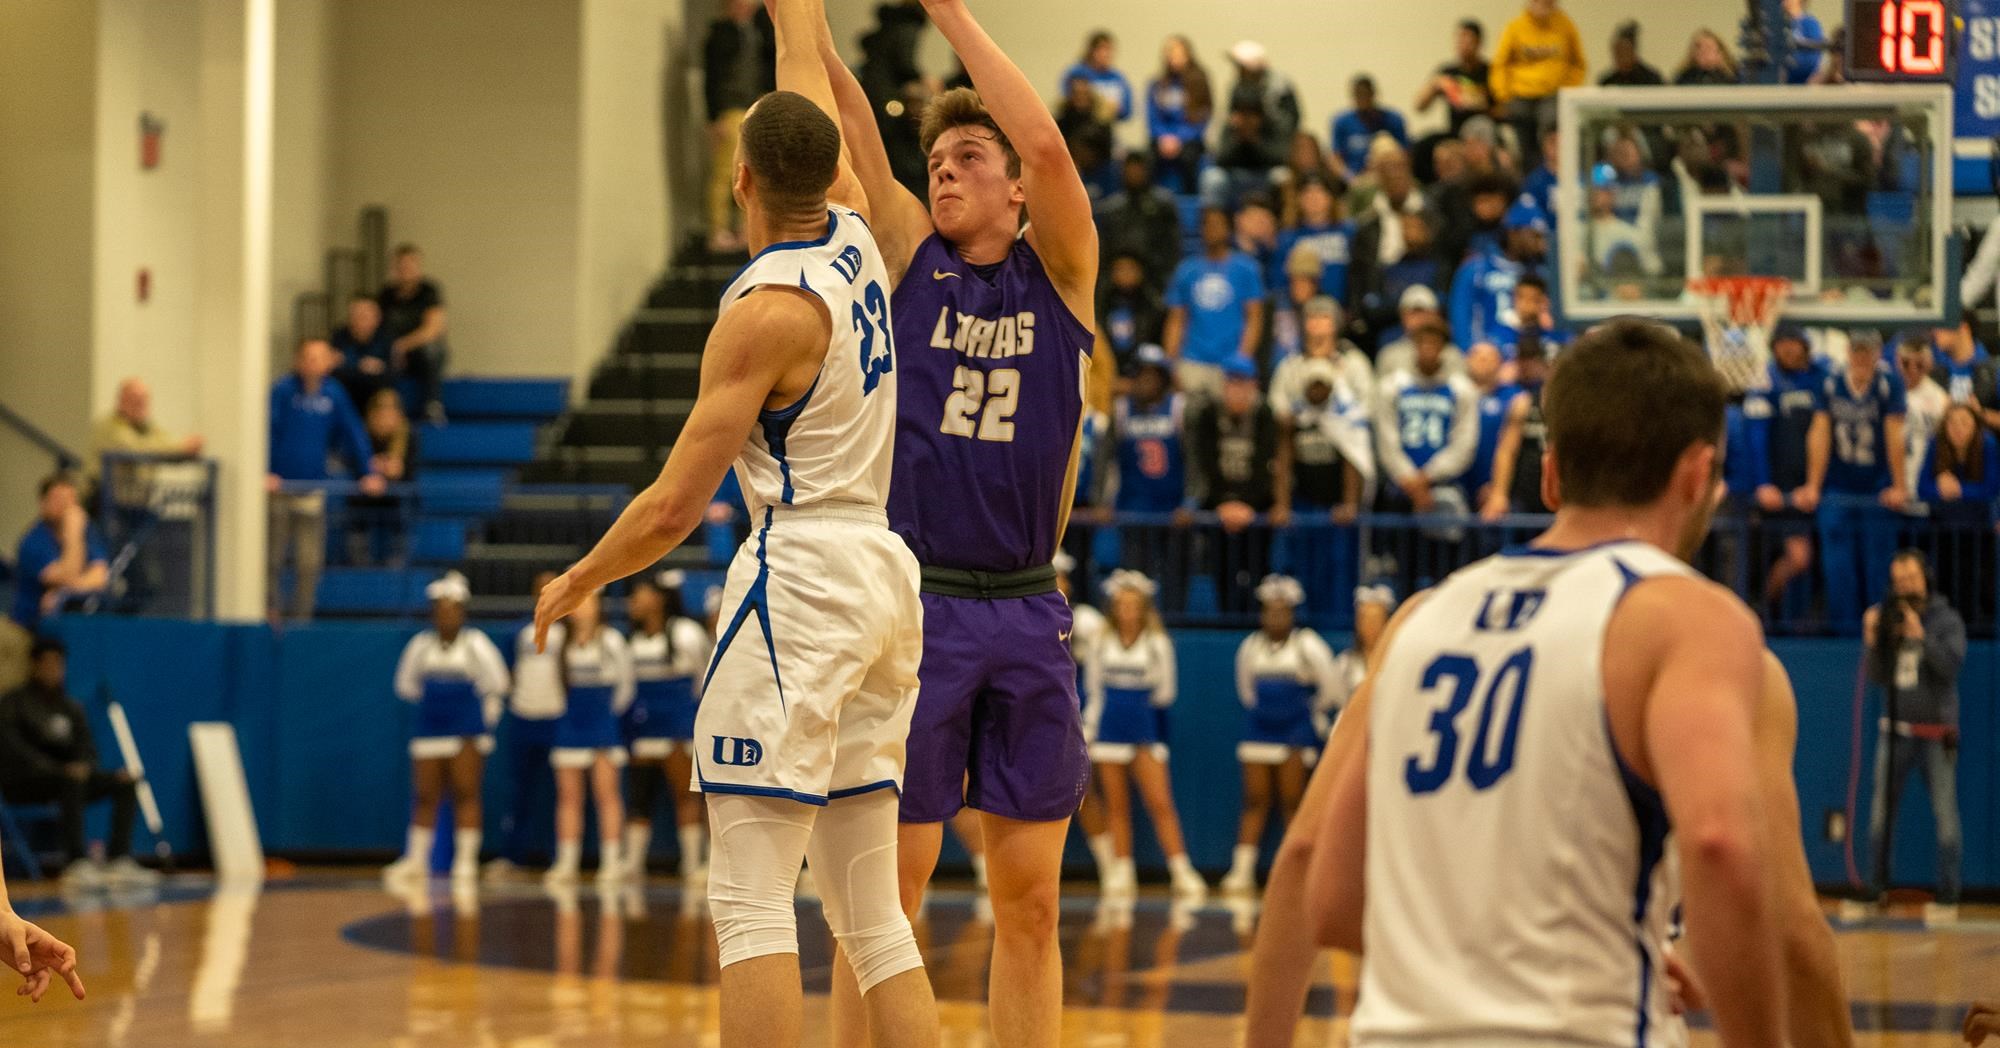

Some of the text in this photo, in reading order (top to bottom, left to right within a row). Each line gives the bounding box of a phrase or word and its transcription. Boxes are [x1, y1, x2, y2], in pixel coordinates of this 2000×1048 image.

[1879, 0, 1944, 74] 10
[1969, 17, 2000, 60] S
[1974, 74, 2000, 119] S
[852, 279, 892, 397] 23
[940, 365, 1021, 442] 22
[712, 735, 763, 766] UD
[1405, 646, 1533, 793] 30
